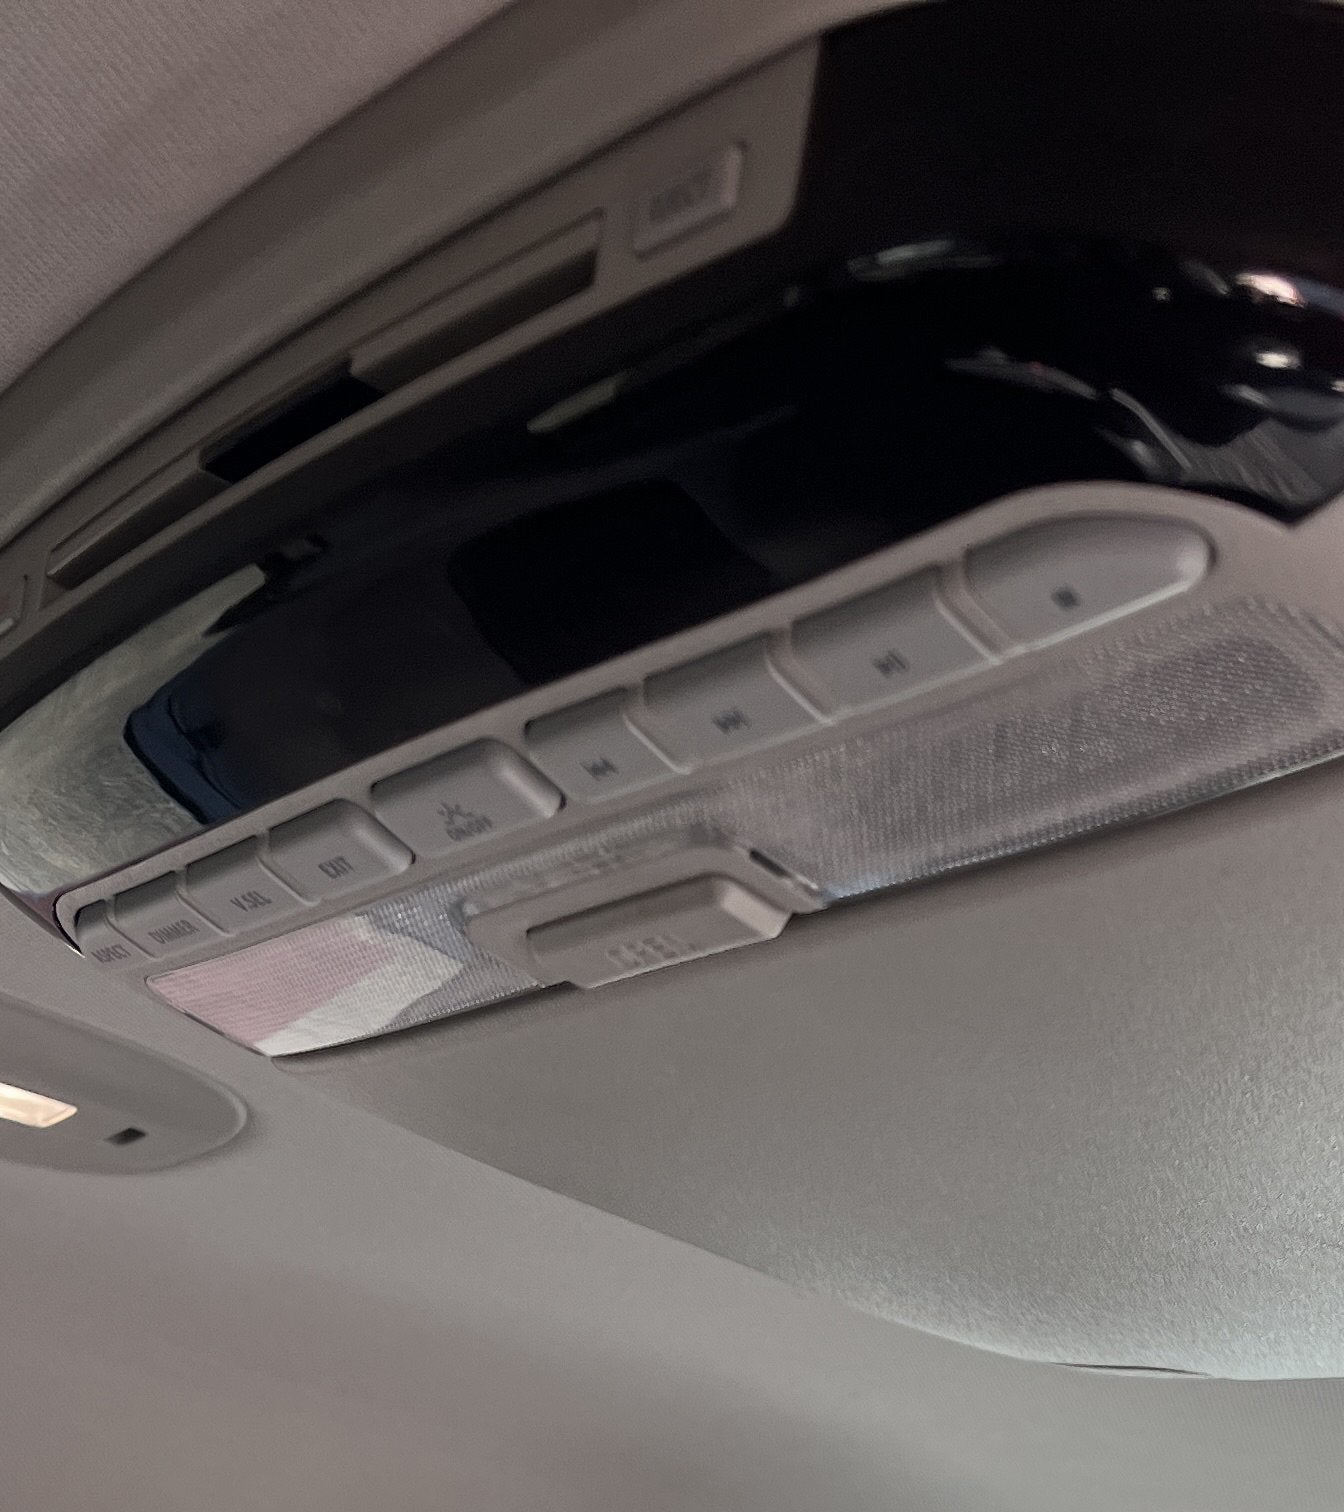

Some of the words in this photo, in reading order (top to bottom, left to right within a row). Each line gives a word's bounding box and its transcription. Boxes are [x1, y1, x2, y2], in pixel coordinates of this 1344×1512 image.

[318, 856, 355, 879] EXIT
[148, 918, 201, 946] DIMMER
[90, 943, 132, 965] ASPECT
